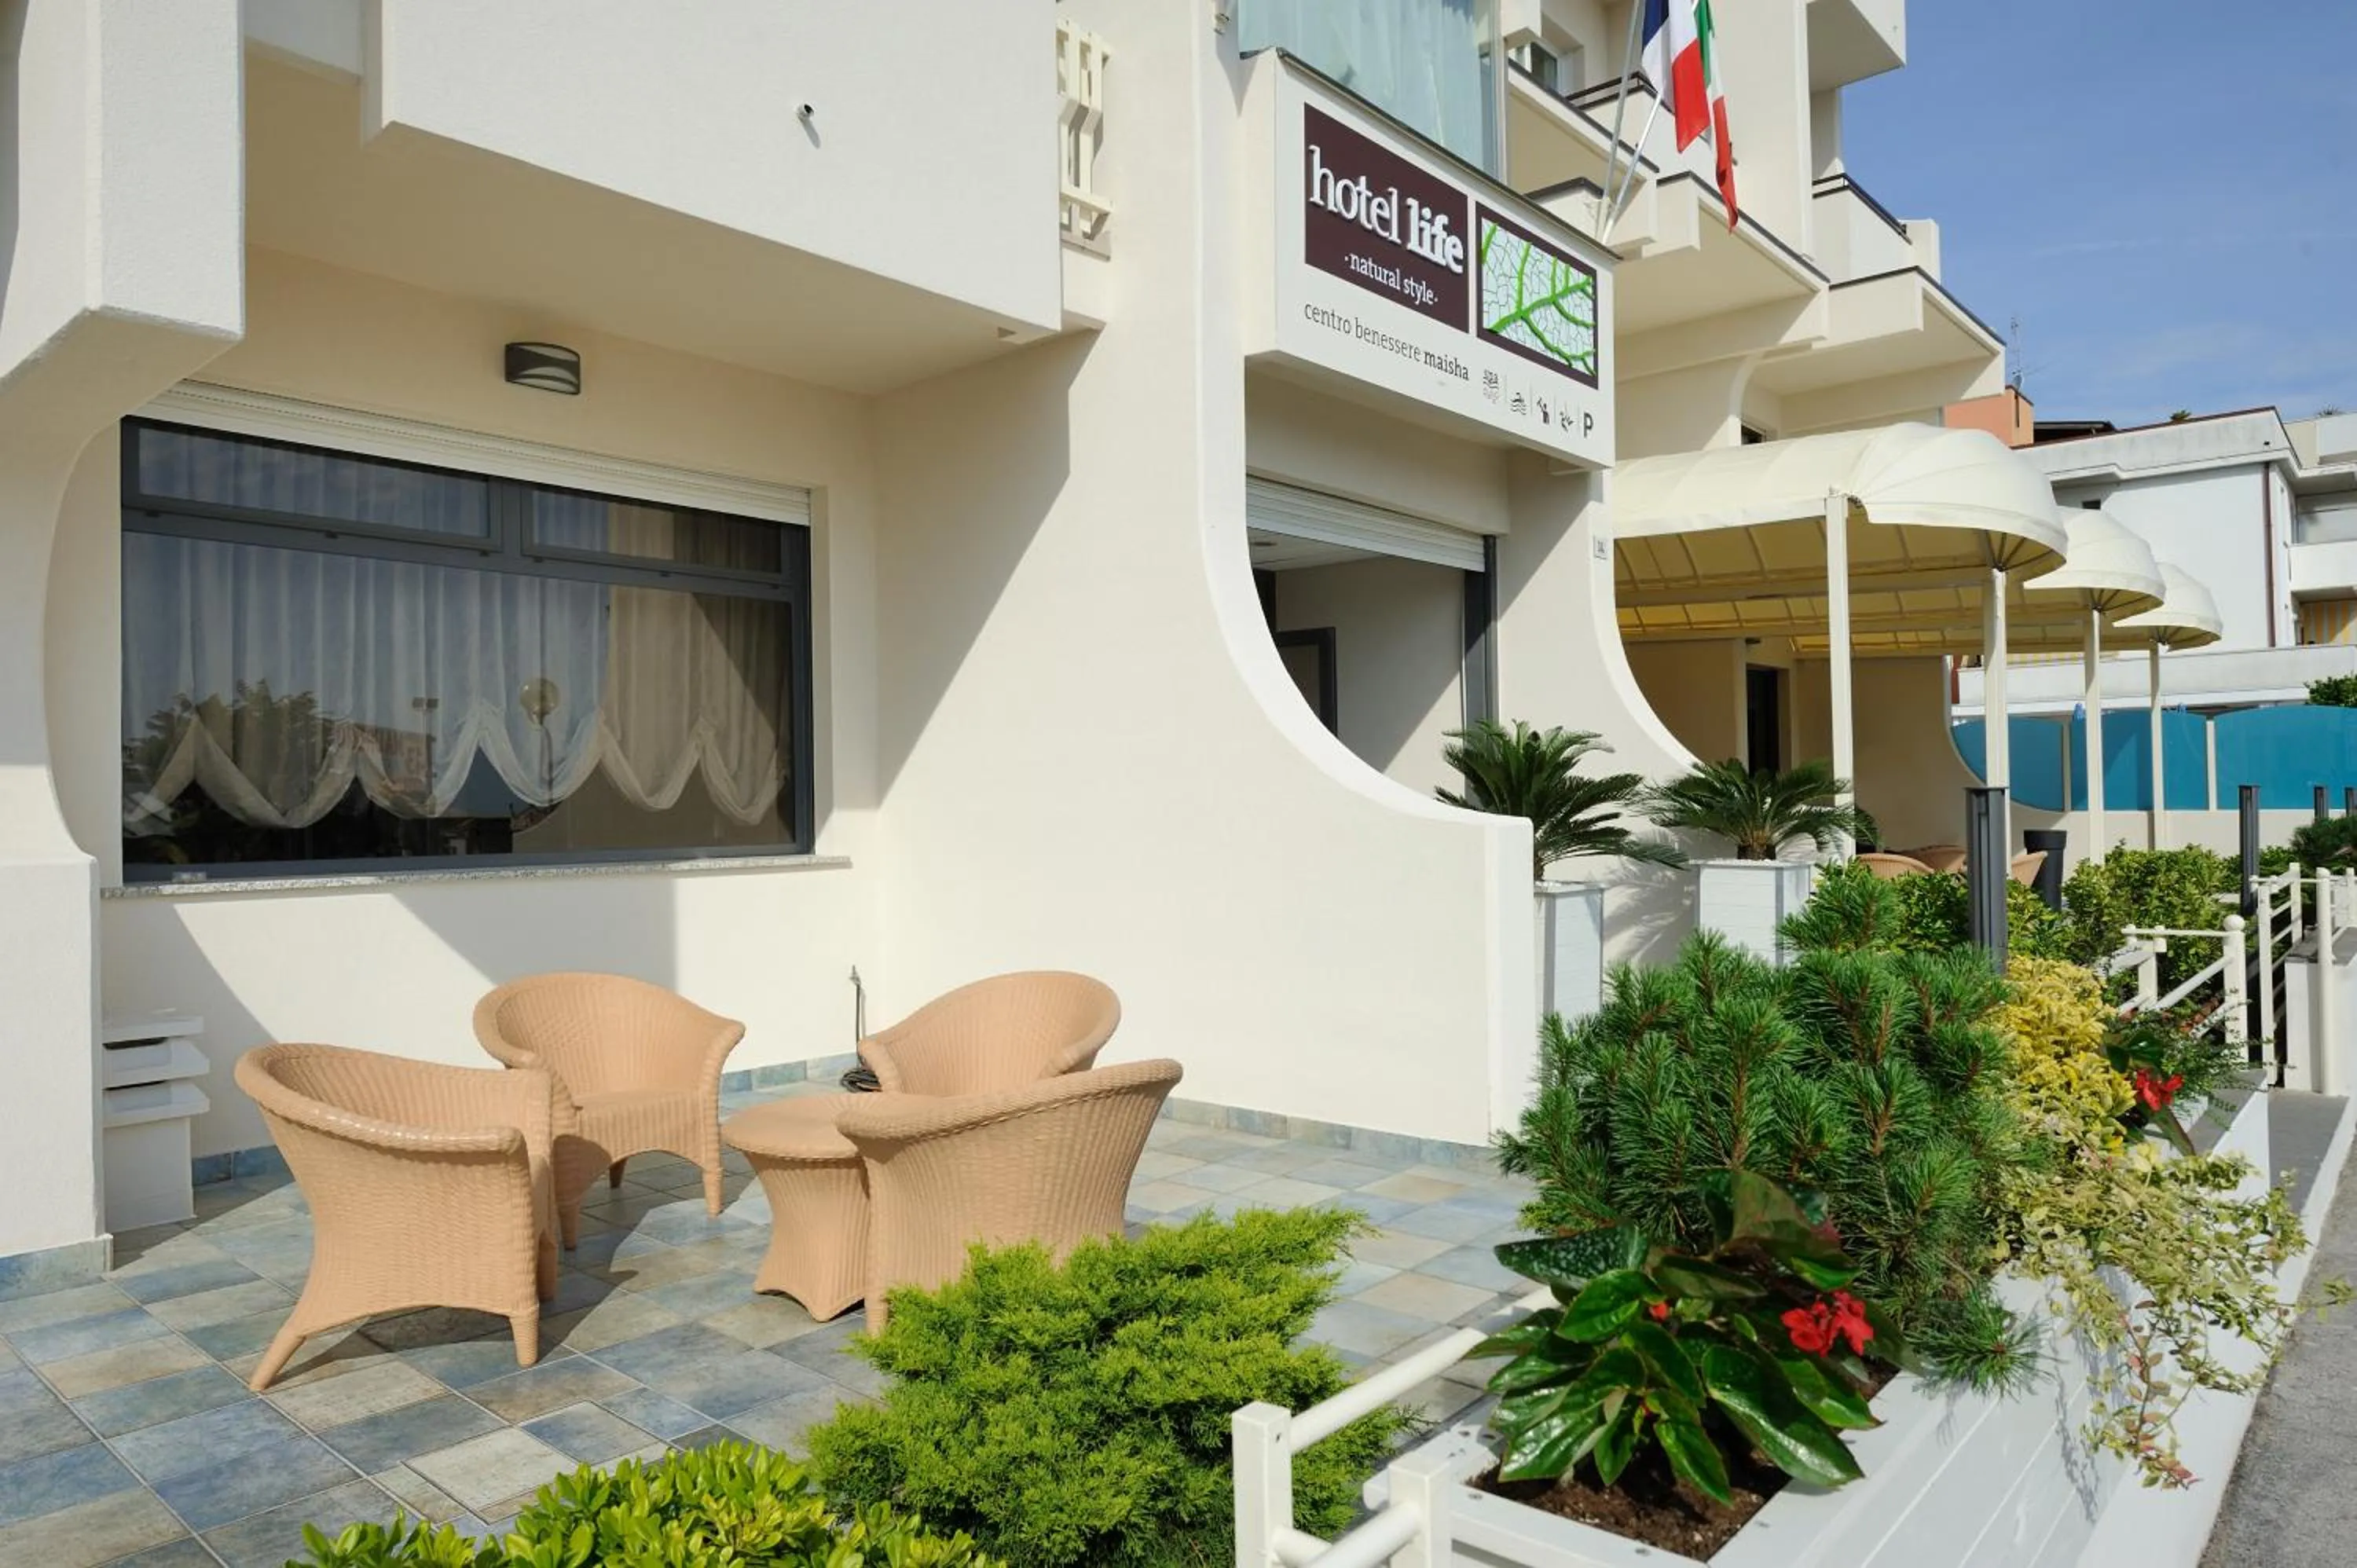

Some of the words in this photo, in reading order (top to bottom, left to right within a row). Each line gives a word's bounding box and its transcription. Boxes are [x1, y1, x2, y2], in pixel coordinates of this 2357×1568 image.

[1308, 145, 1402, 244] hotel
[1406, 197, 1464, 274] life
[1304, 303, 1352, 335] centro
[1354, 317, 1421, 362] benessere
[1423, 350, 1470, 381] maisha
[1583, 411, 1594, 438] P
